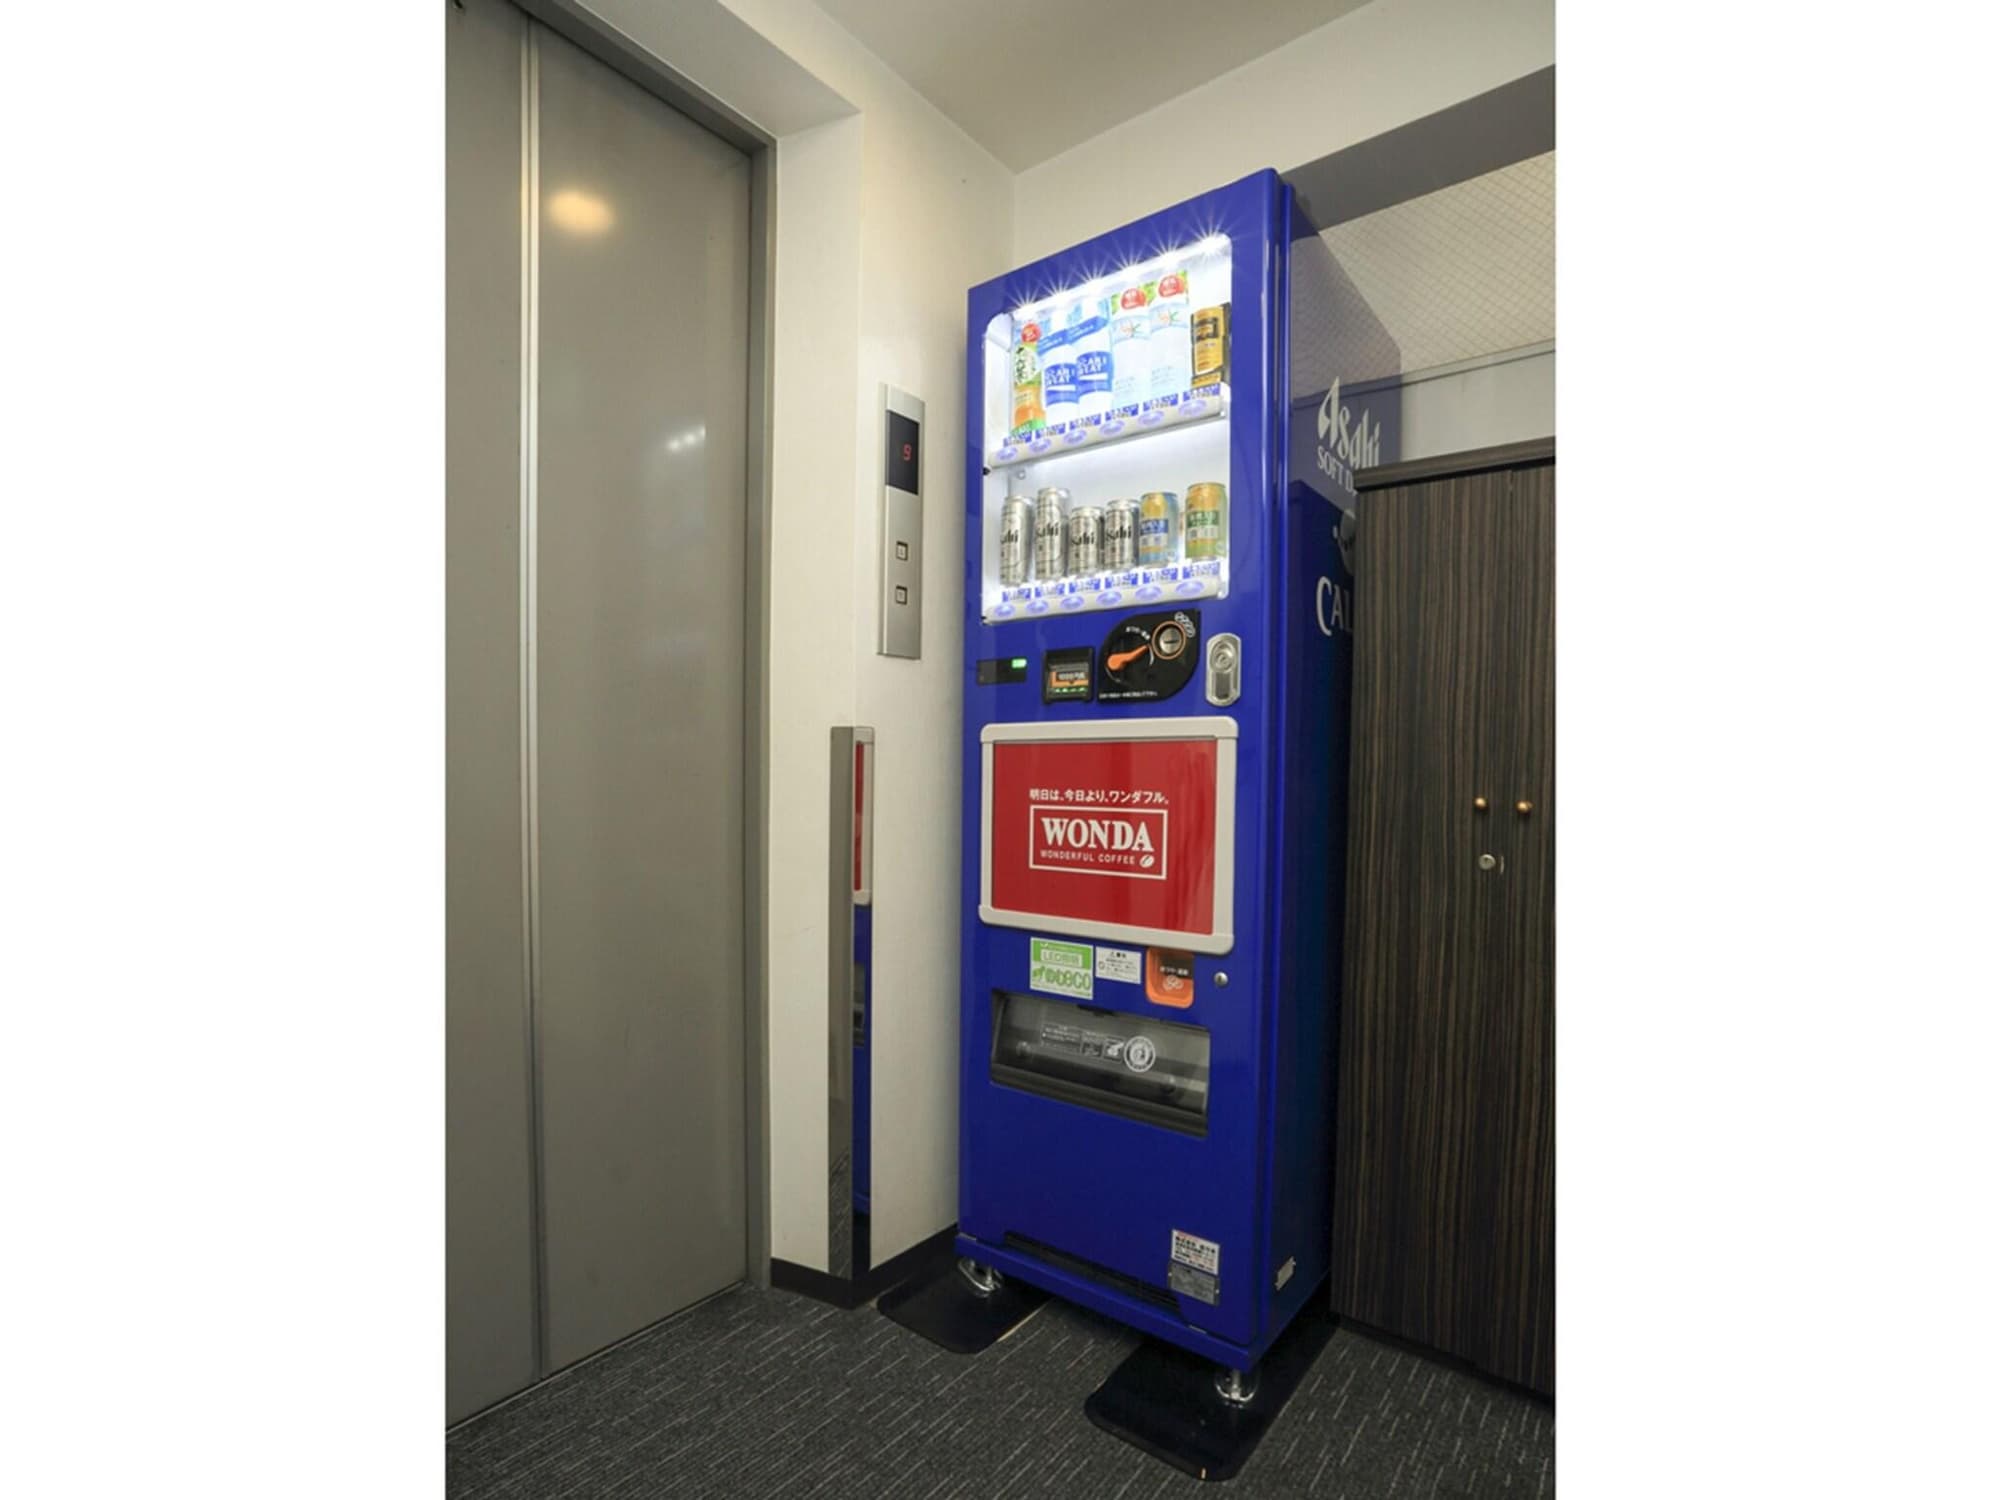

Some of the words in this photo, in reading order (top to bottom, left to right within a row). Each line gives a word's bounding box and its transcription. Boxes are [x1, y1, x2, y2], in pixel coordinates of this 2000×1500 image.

[1318, 376, 1380, 469] Asahi
[903, 443, 911, 461] 9
[1317, 445, 1344, 487] SOFT
[1041, 817, 1154, 852] WONDA
[1040, 850, 1094, 862] WONDERFUL
[1098, 854, 1135, 865] COFFEE
